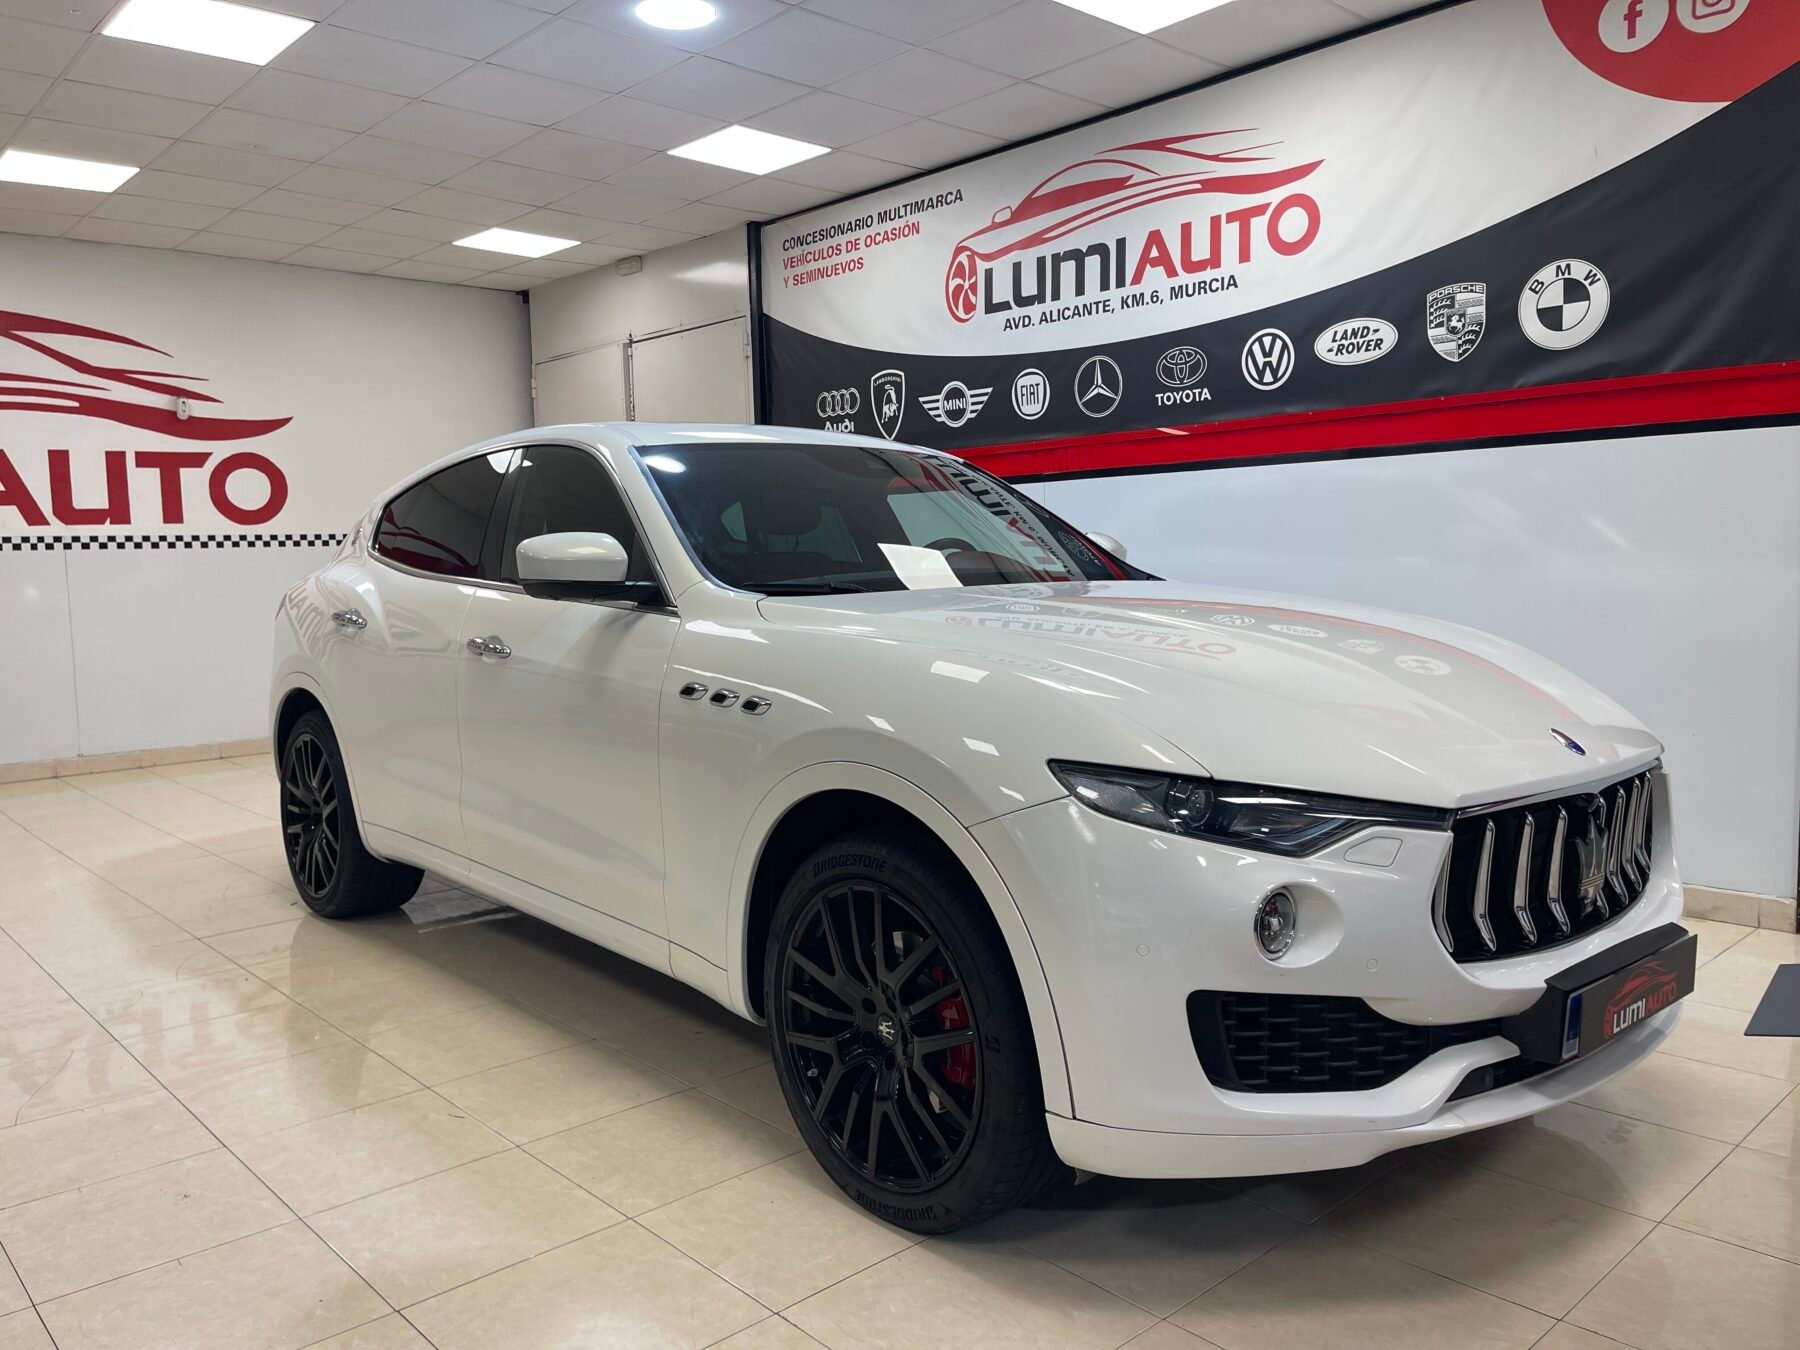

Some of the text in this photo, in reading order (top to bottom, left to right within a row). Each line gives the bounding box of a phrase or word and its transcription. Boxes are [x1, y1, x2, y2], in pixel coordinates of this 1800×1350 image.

[782, 188, 964, 252] CONCESIONARIO MULTIMARCA
[782, 220, 921, 271] VEHÍCULOS DE OCASIÓN
[783, 256, 865, 289] Y SEMINUEVOS
[1528, 262, 1602, 296] BMW
[1003, 274, 1239, 332] AVD. ALICANTE, KM.6, MURCIA
[1429, 284, 1485, 303] PORSCHE
[1331, 325, 1372, 344] LAND
[1334, 337, 1384, 357] ROVER
[943, 398, 967, 412] MINI
[1020, 382, 1041, 407] FIAT
[1155, 388, 1212, 407] TOYOTA
[824, 418, 855, 433] Audi
[812, 853, 888, 879] BRIDGESTONE
